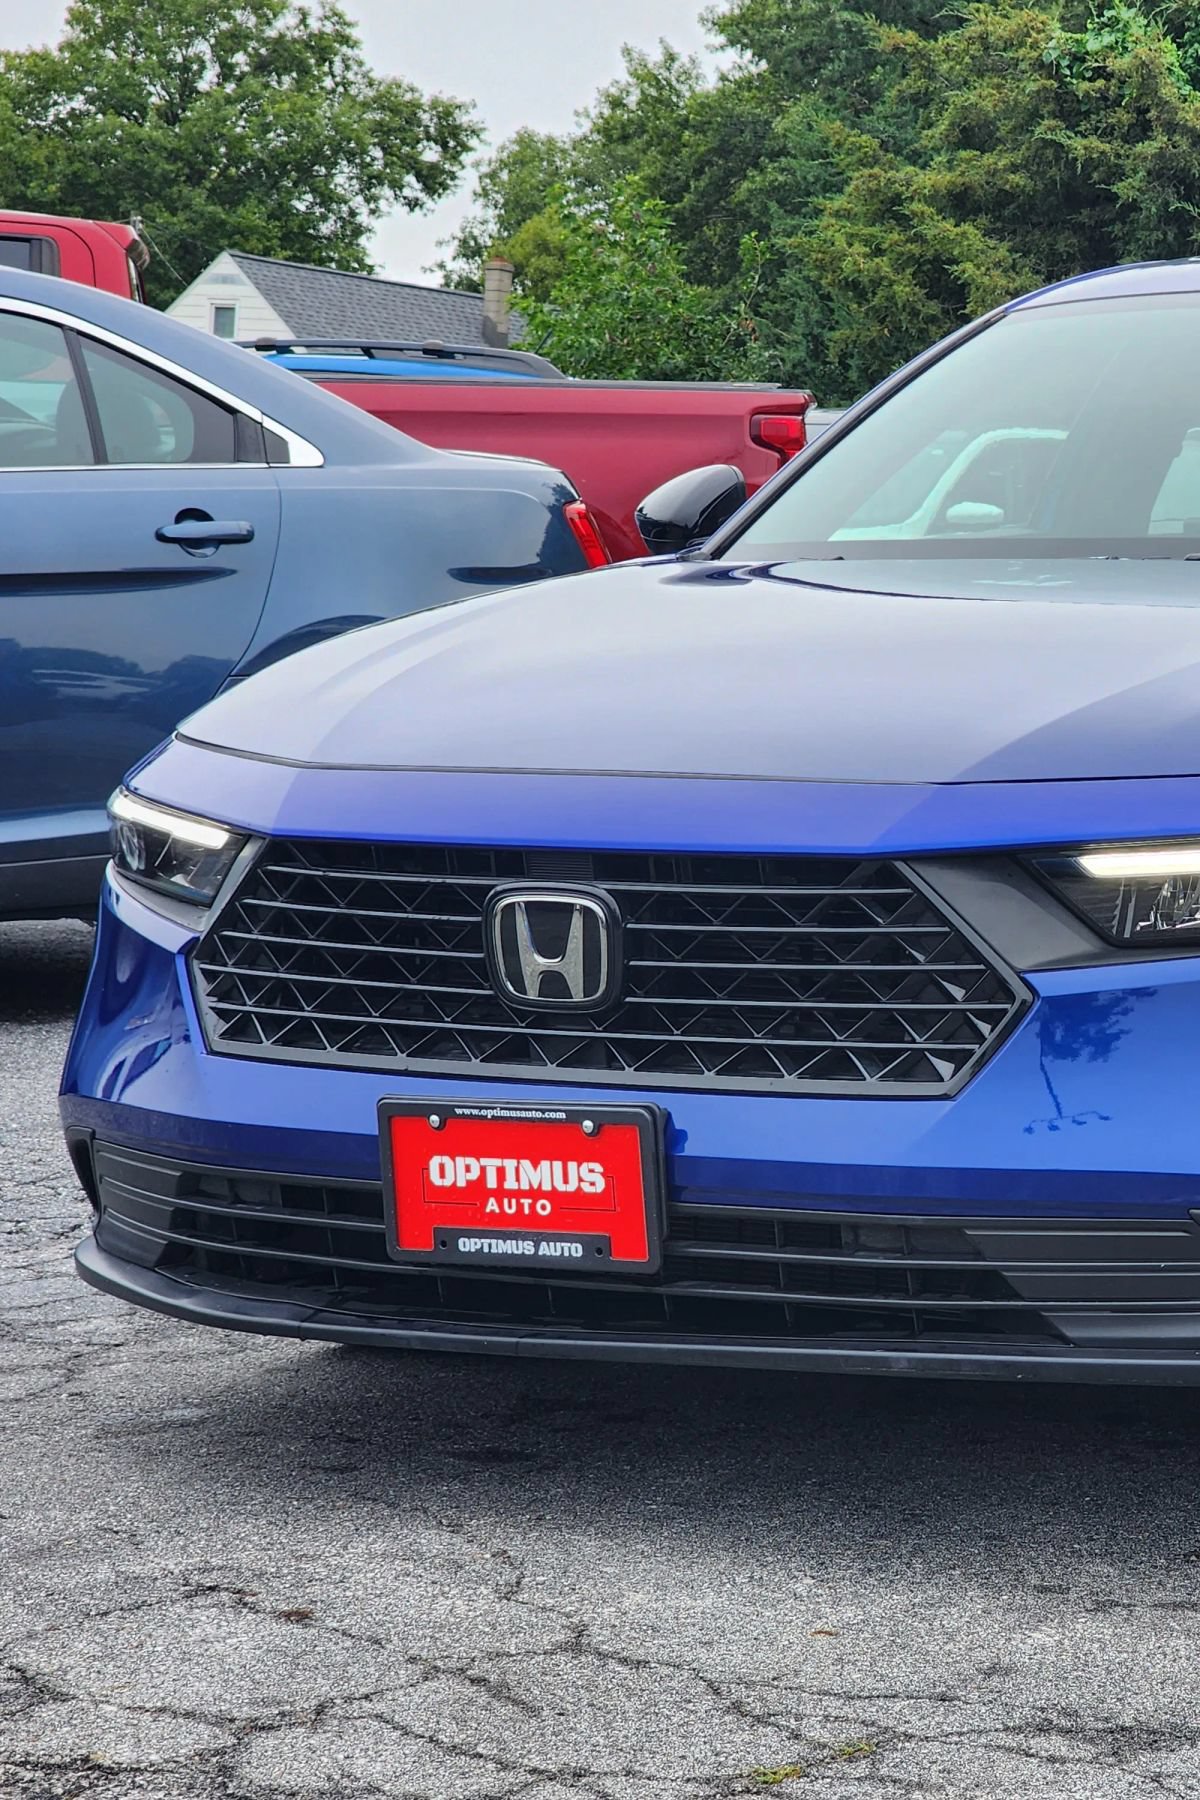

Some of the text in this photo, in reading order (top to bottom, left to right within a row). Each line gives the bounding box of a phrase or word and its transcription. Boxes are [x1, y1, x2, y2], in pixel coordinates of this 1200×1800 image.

[454, 1107, 567, 1120] www.optimusauto.com
[428, 1155, 606, 1194] OPTIMUS
[485, 1197, 552, 1216] AUTO
[458, 1237, 583, 1258] OPTIMUS AUTO
